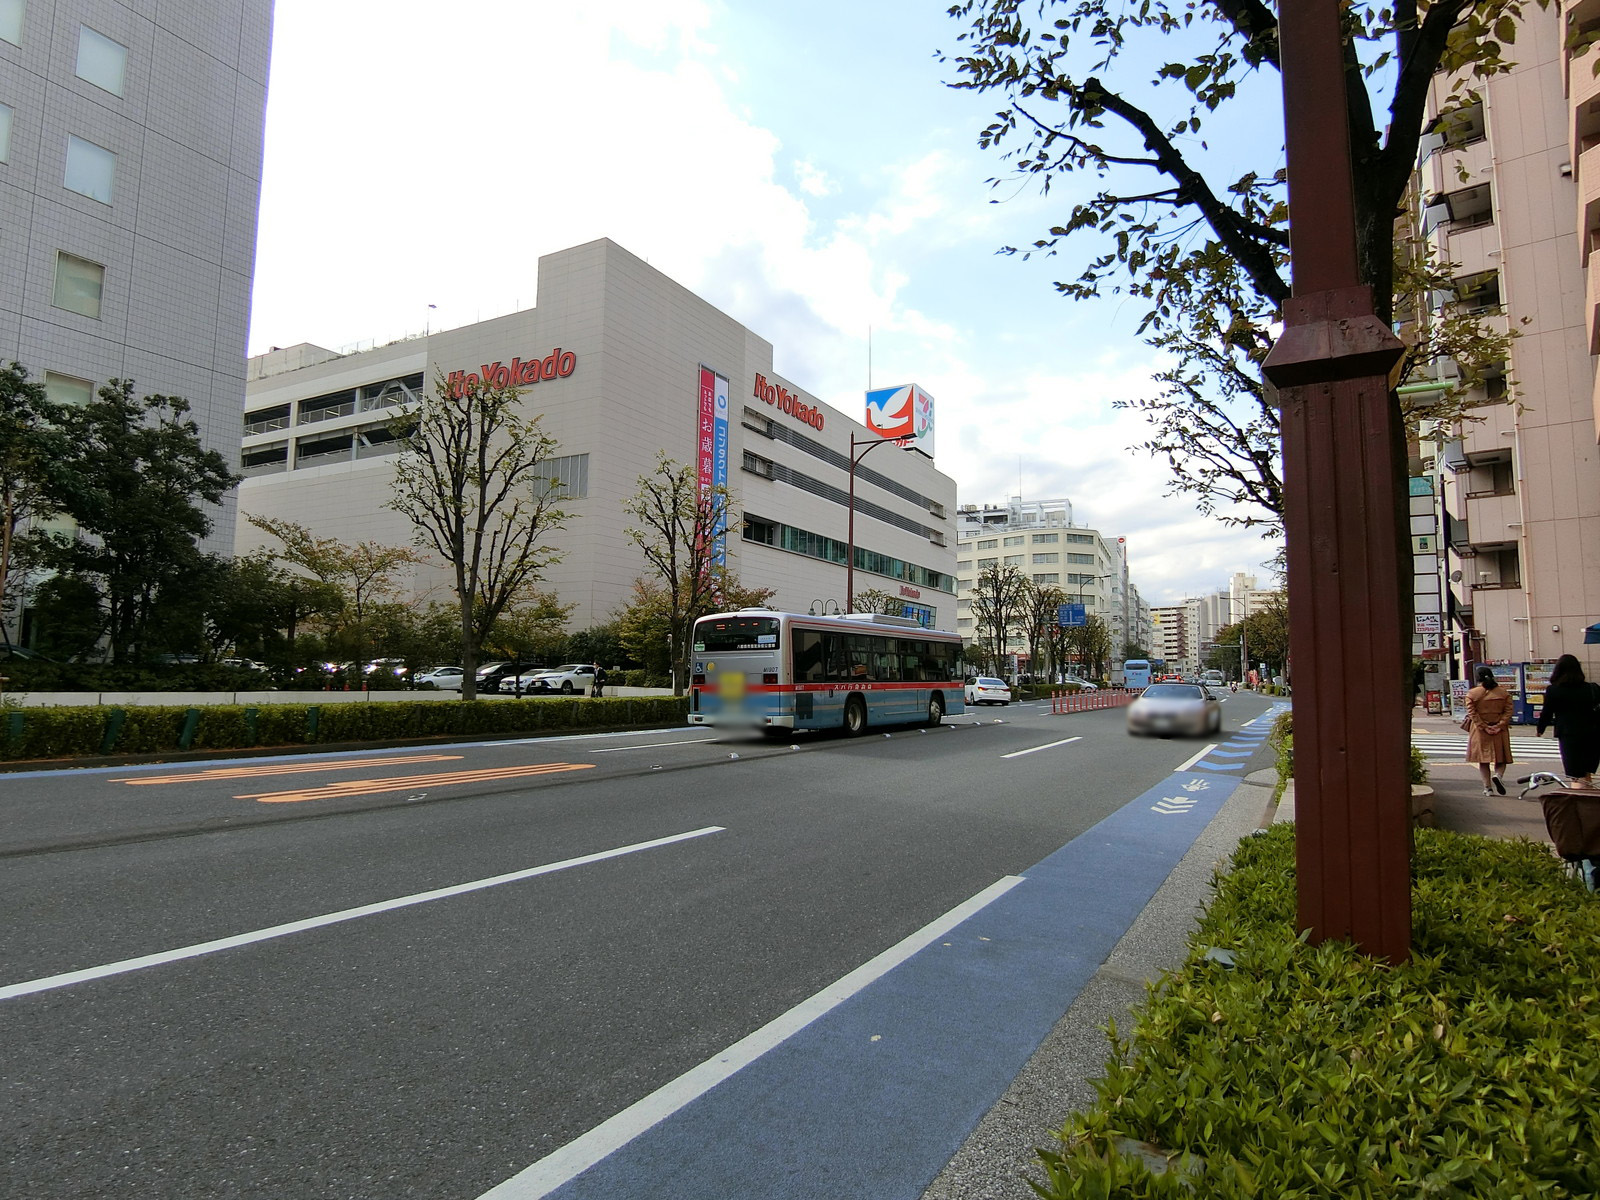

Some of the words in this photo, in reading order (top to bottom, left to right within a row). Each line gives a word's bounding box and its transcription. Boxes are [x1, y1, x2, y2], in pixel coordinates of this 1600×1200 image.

[446, 369, 479, 399] Ito
[480, 347, 577, 391] Yokado
[754, 373, 776, 405] Ito
[775, 384, 825, 432] Yokado
